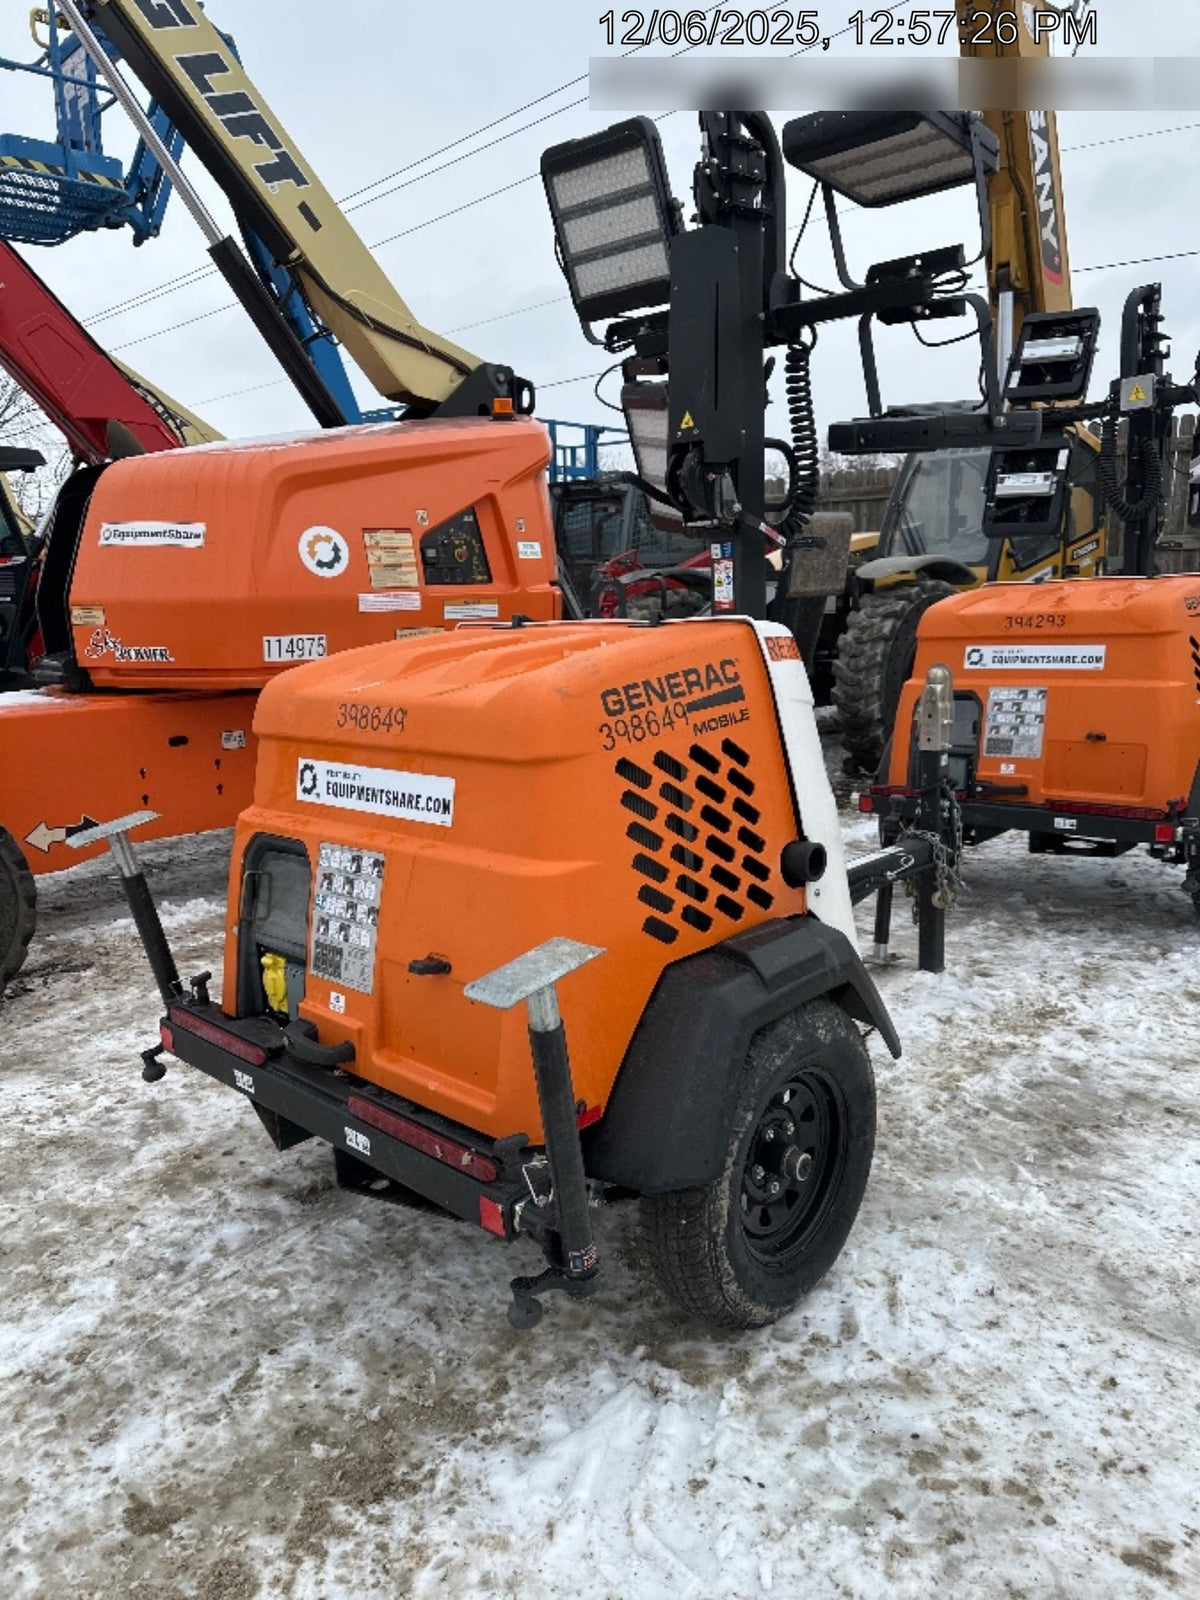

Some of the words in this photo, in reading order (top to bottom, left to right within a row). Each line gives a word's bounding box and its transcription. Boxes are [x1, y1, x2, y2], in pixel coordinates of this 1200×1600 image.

[172, 51, 311, 189] LIFT
[112, 528, 203, 541] EquipmentShare
[1004, 614, 1067, 632] 394293
[264, 636, 326, 660] 114975
[991, 654, 1104, 665] EQUIPMENTSHARE.COM
[600, 658, 742, 718] GENERAC
[337, 703, 408, 734] 398649
[599, 701, 690, 752] 398649
[692, 708, 750, 737] MOBILE
[326, 781, 451, 816] EQUIPMENTSHARE.COM
